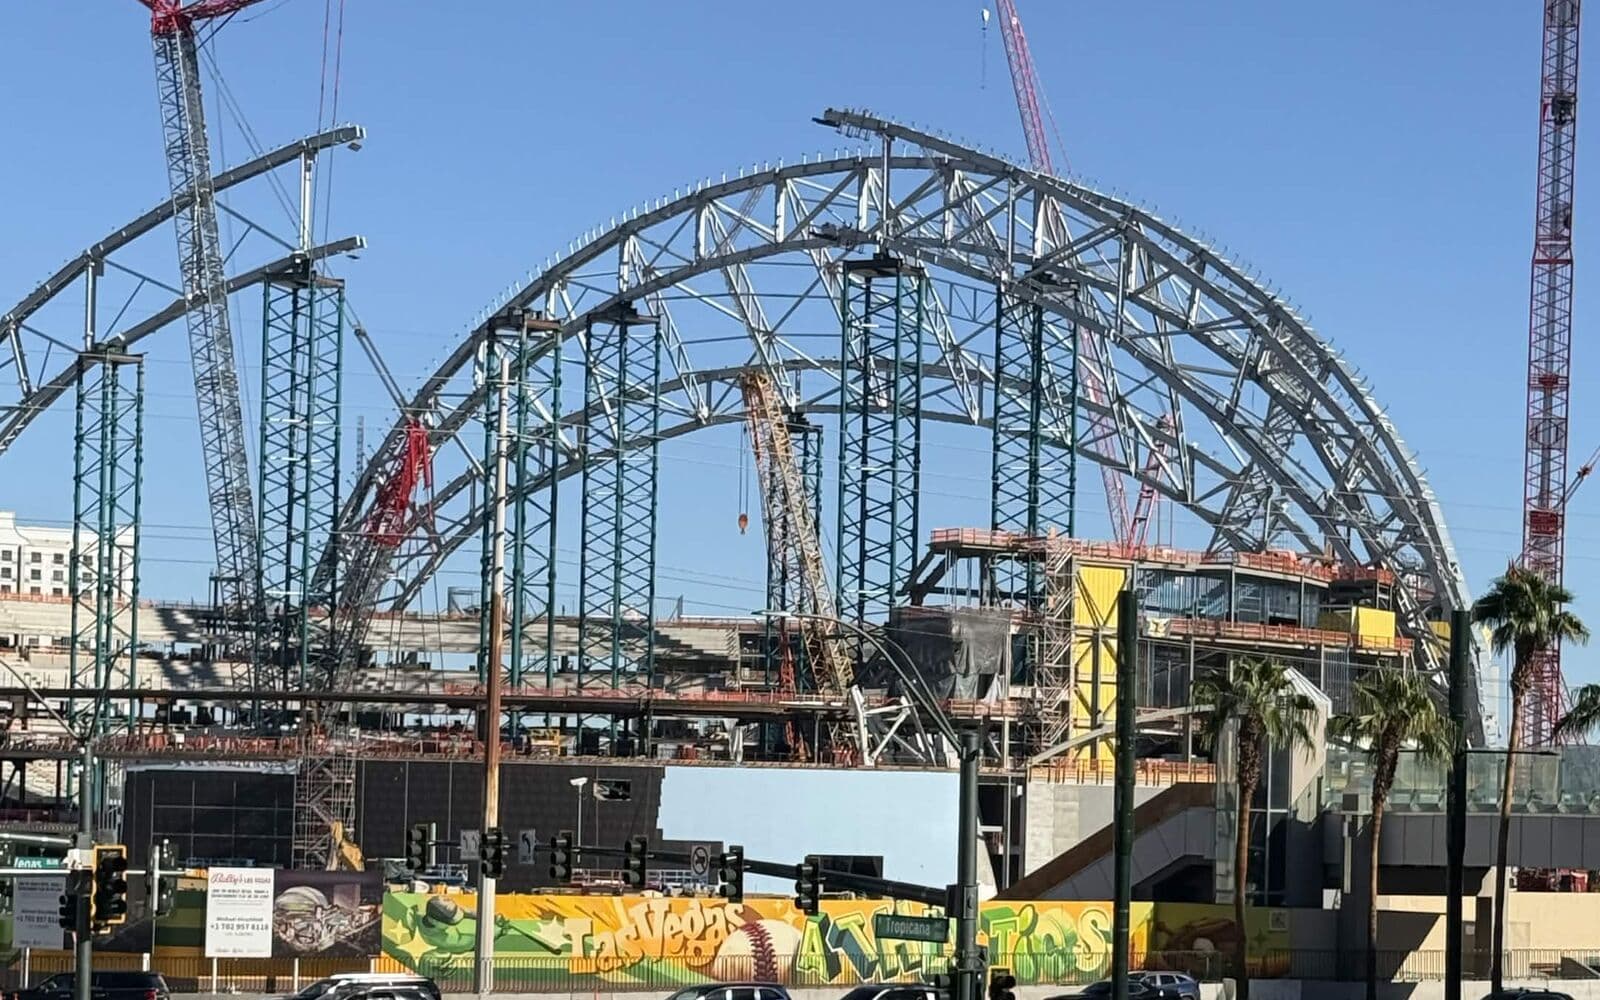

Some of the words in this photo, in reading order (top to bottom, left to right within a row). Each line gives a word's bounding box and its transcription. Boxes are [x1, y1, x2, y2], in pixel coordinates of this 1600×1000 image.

[236, 923, 250, 931] 957
[628, 898, 745, 967] Vegas
[884, 918, 930, 936] Tropicana
